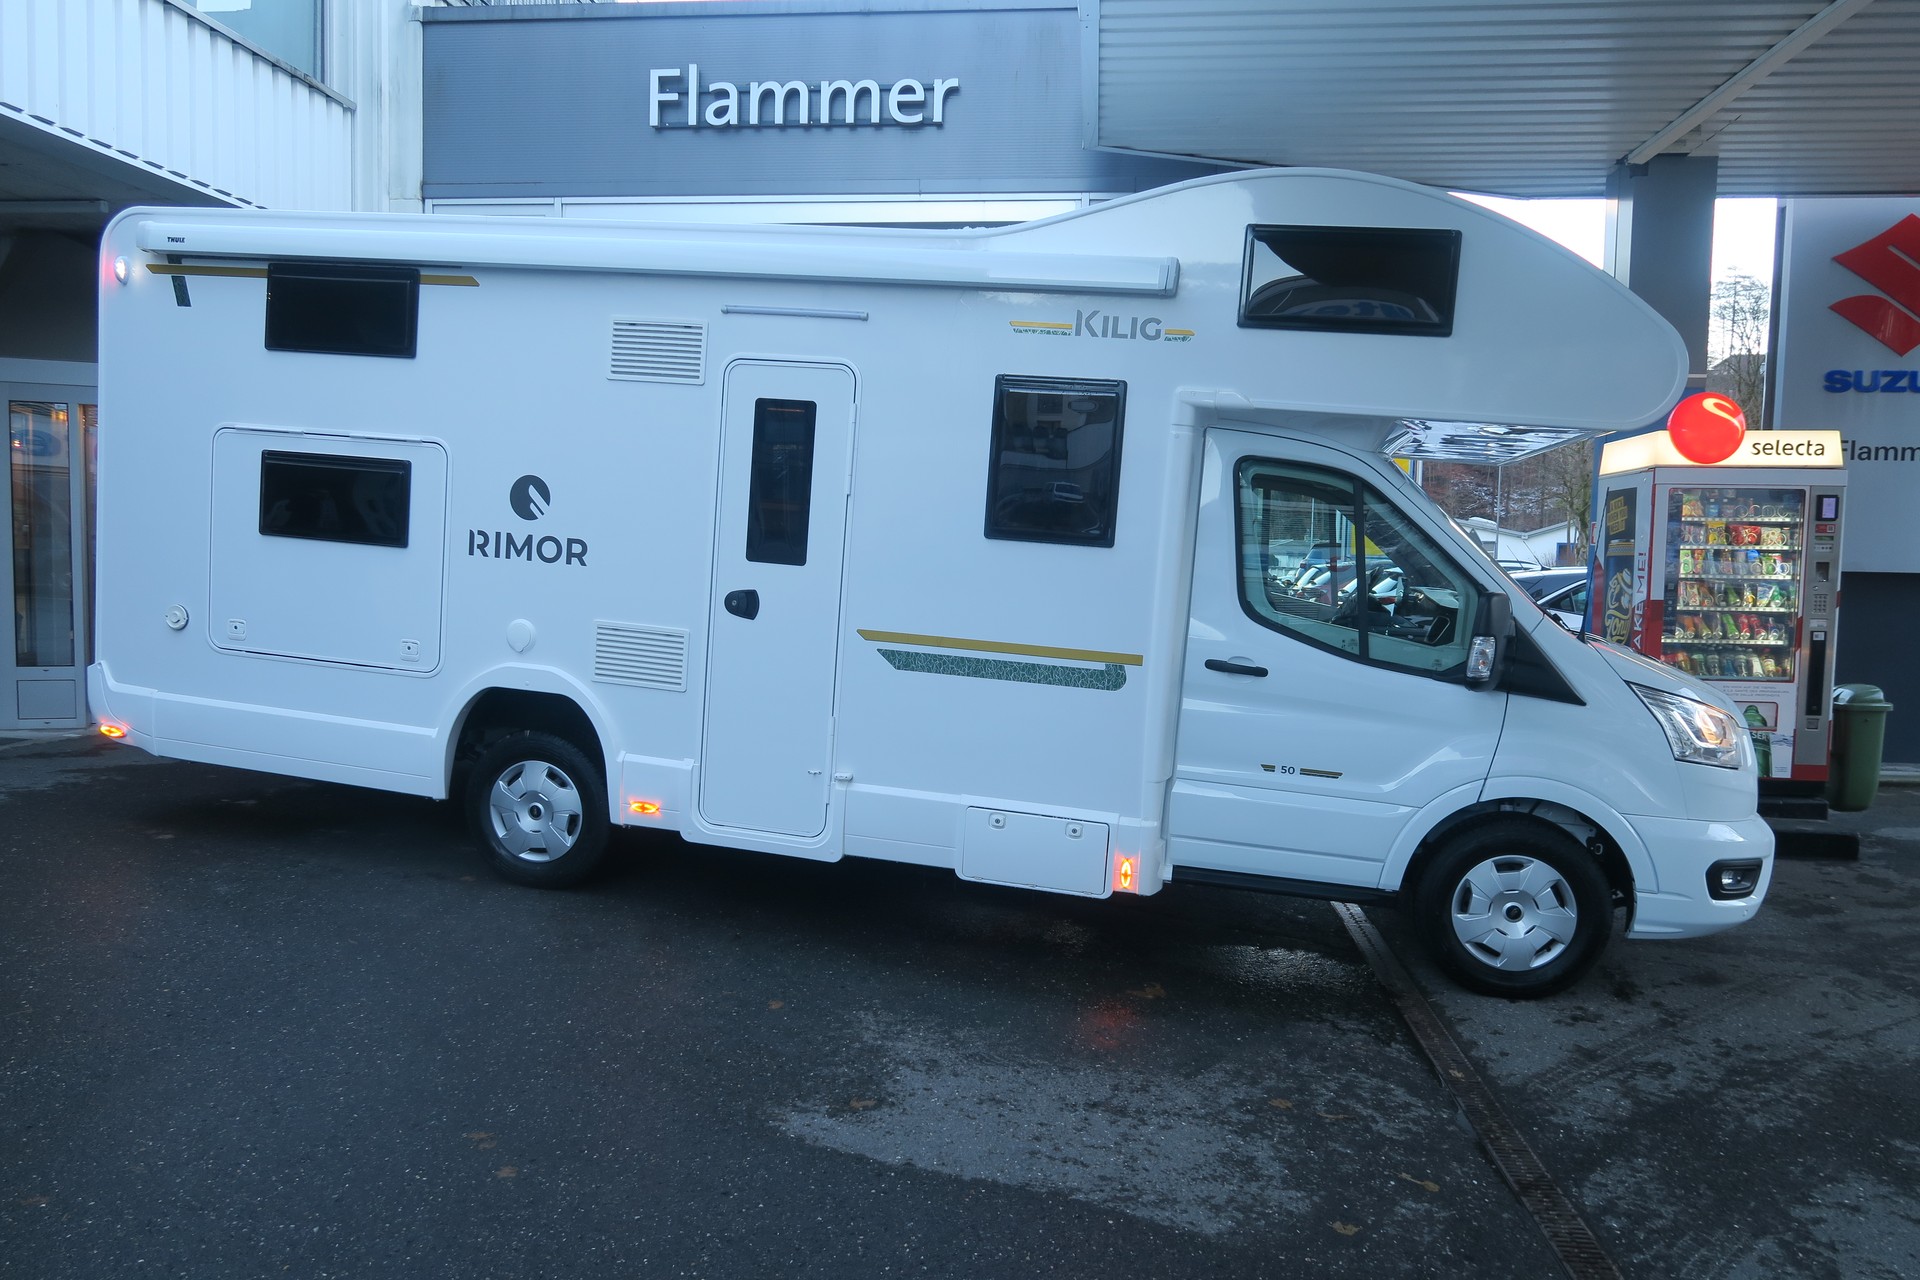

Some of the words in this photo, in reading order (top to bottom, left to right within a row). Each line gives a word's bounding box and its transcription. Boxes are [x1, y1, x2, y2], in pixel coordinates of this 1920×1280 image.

[650, 63, 959, 127] Flammer
[1075, 309, 1162, 341] KILIG
[1751, 440, 1825, 456] selecta
[468, 529, 588, 566] RIMOR
[1636, 553, 1646, 594] ME!
[1634, 602, 1644, 649] AKE
[1751, 731, 1768, 742] SER
[1281, 766, 1295, 775] 50
